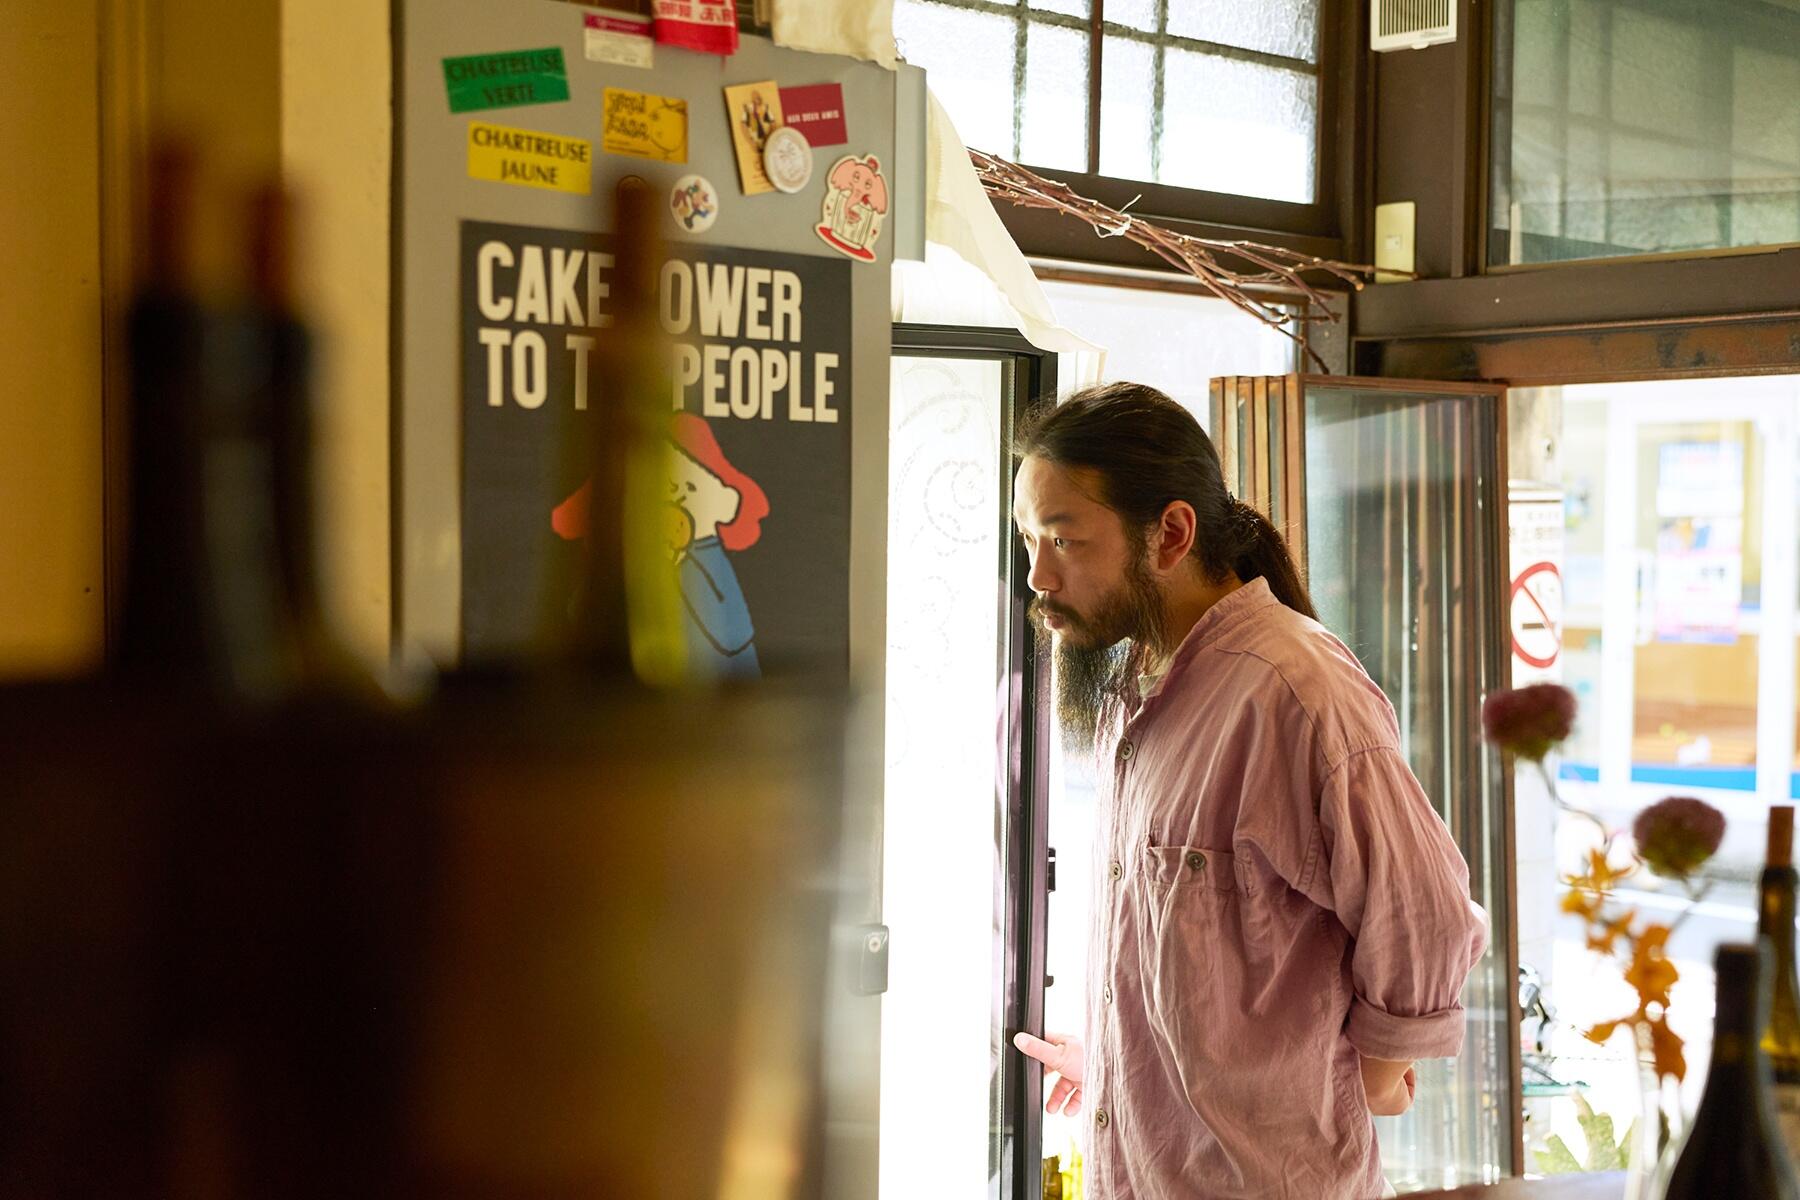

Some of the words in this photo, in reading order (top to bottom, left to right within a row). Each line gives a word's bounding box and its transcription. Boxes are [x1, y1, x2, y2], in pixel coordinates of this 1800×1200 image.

[472, 126, 588, 163] CHARTREUSE
[501, 159, 559, 185] JAUNE
[477, 240, 615, 328] CAKE
[657, 258, 803, 343] OWER
[478, 327, 548, 410] TO
[669, 343, 840, 423] PEOPLE
